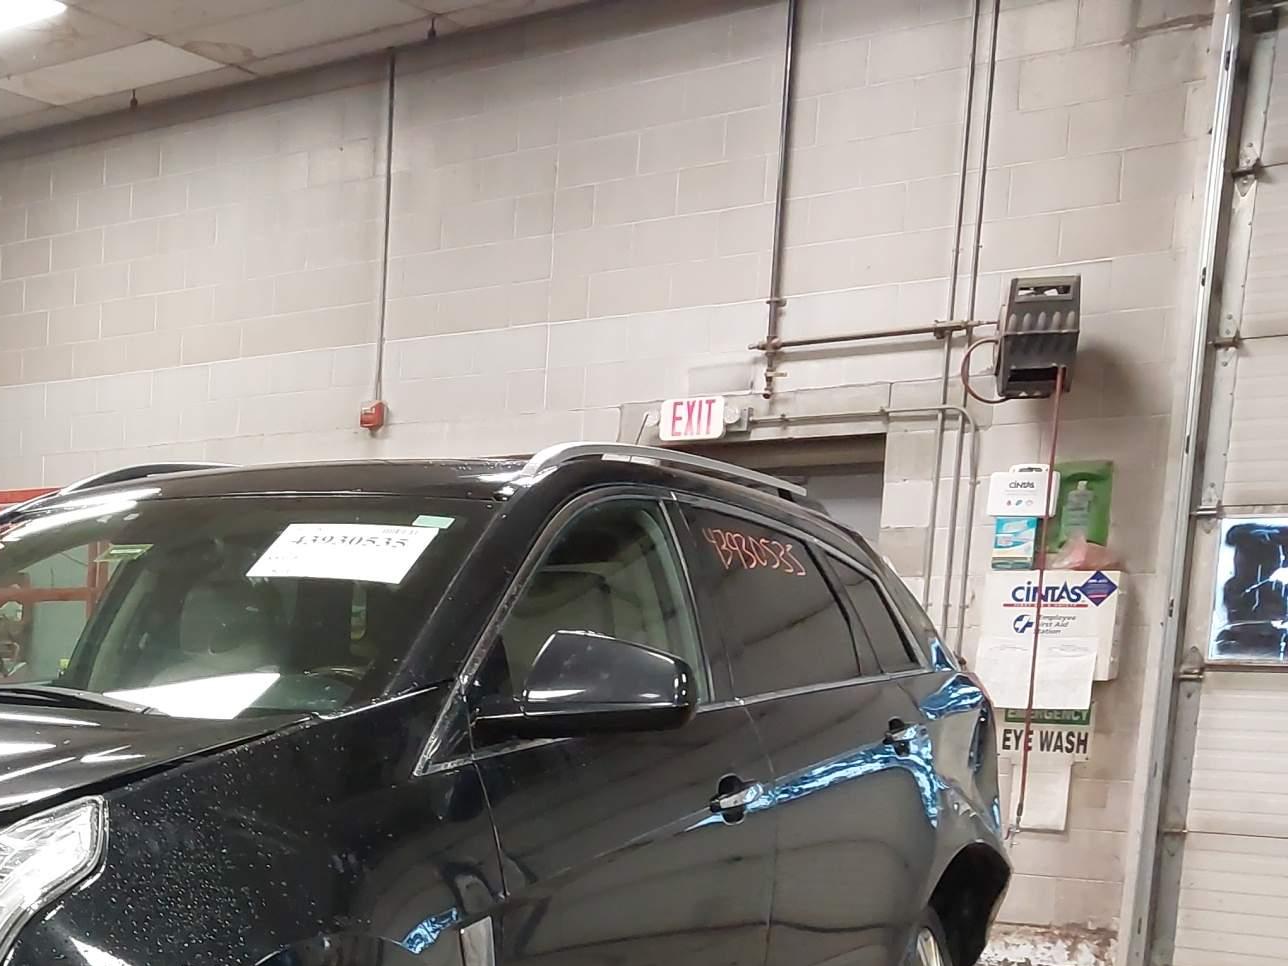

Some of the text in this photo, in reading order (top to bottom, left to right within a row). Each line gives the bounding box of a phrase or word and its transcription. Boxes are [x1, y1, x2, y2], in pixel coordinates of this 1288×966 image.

[671, 399, 716, 437] EXIT
[288, 534, 410, 549] 43930535
[1002, 728, 1089, 754] EYE WASH
